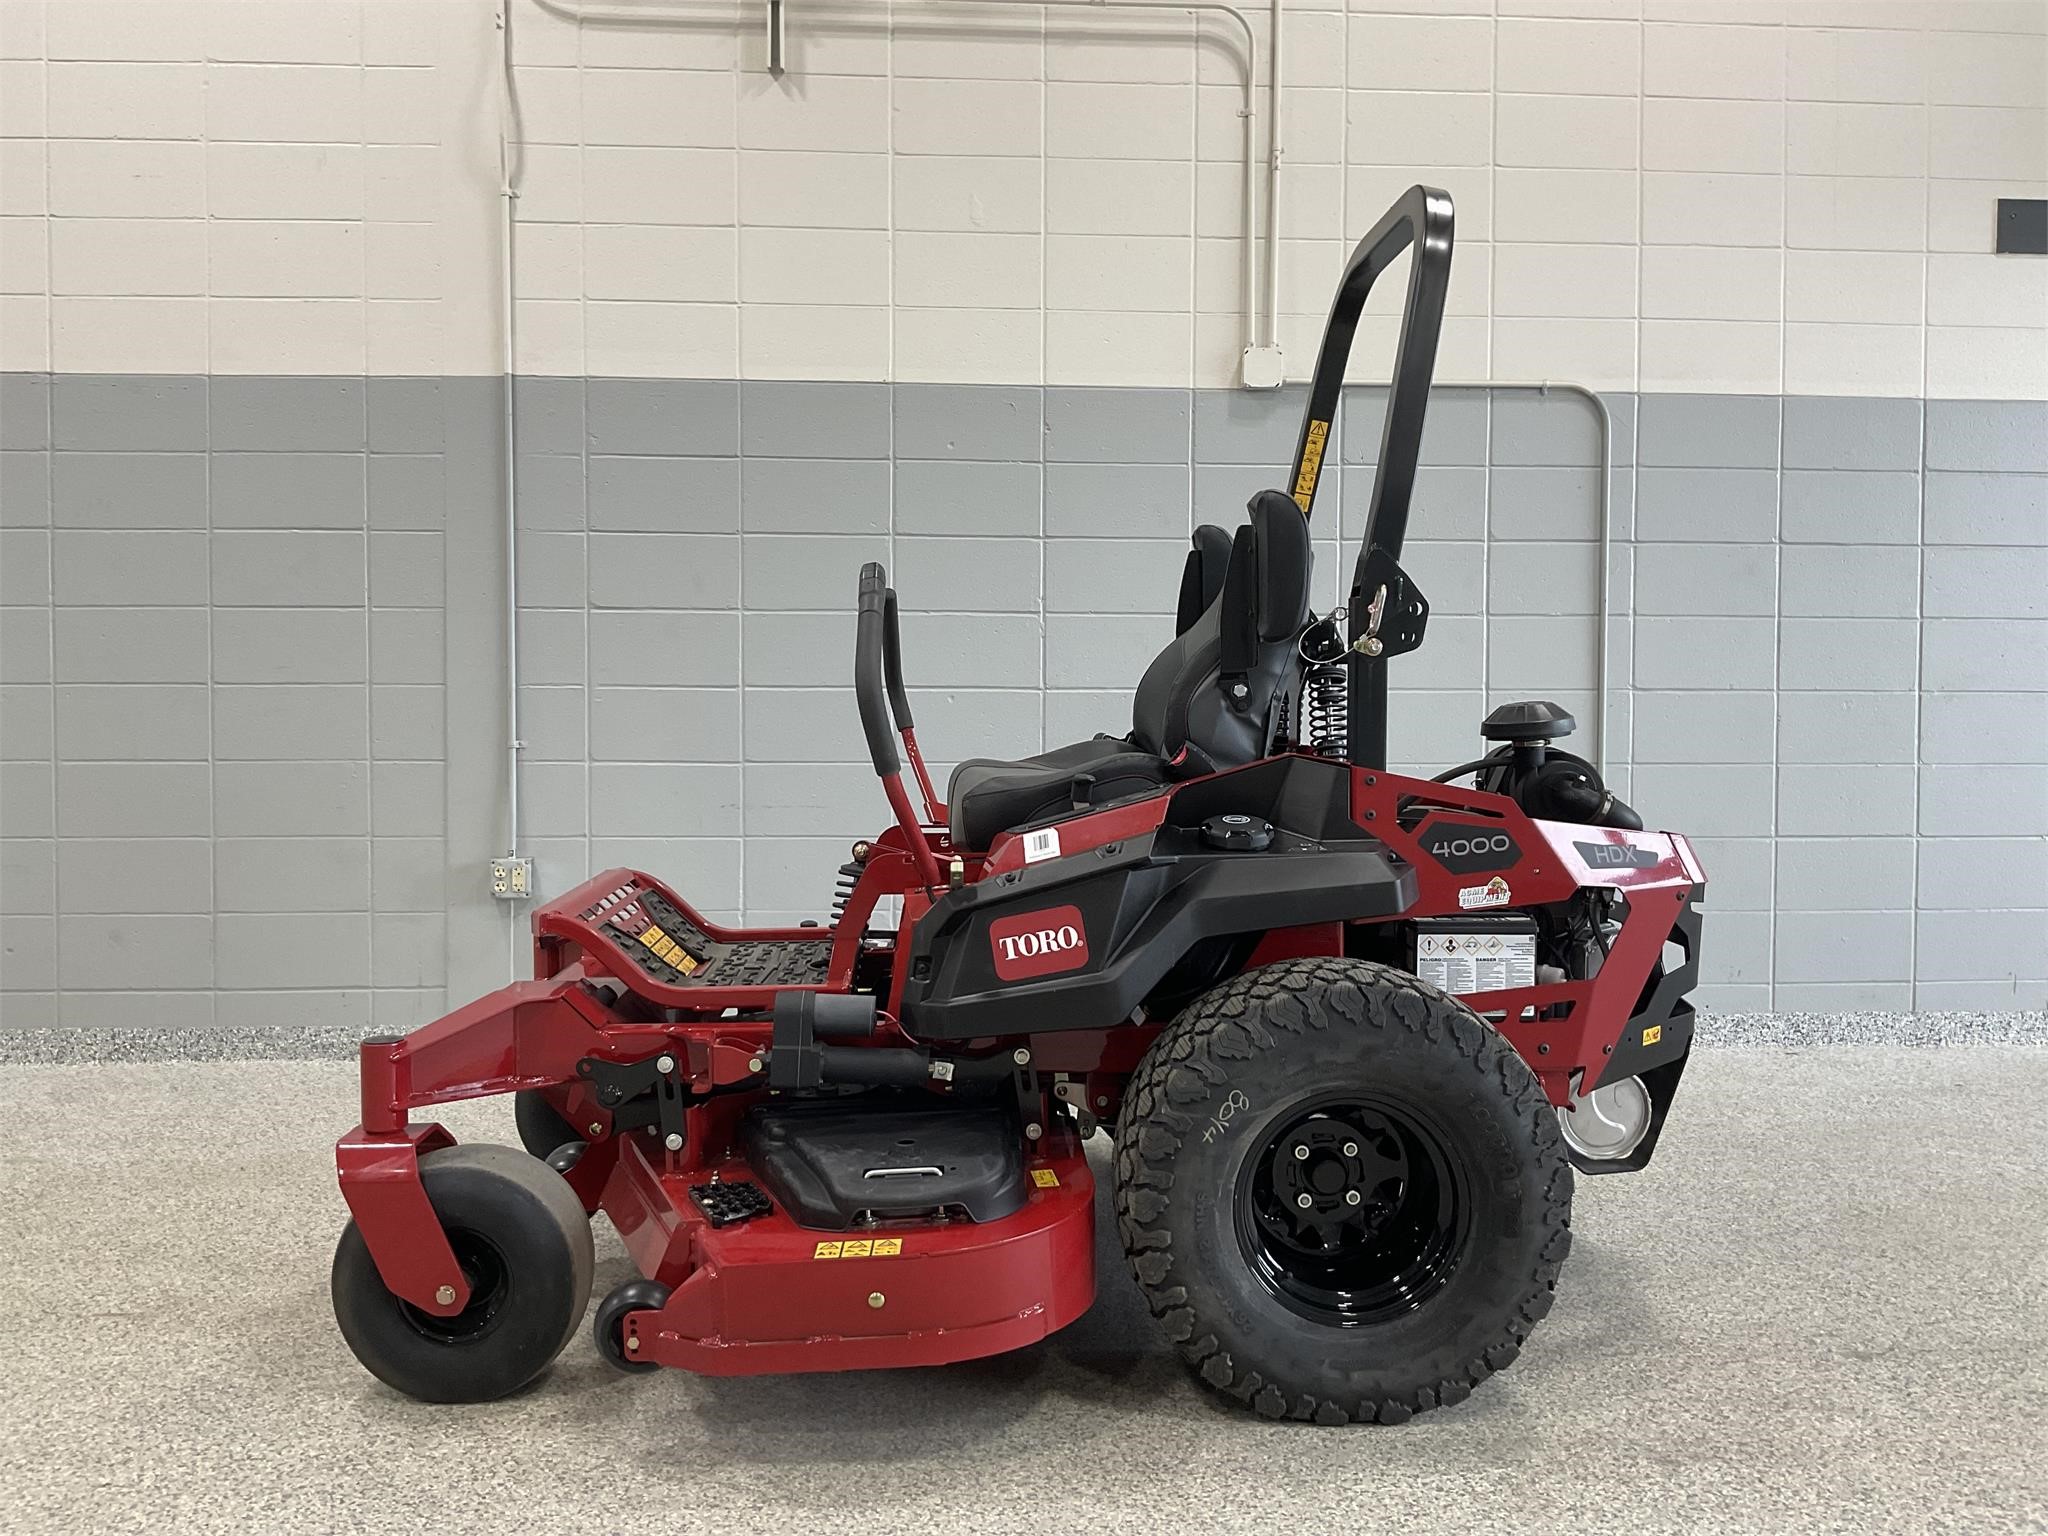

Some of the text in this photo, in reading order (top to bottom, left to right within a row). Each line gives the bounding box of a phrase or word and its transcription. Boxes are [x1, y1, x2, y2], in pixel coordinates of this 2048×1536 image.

[1432, 835, 1510, 858] 4000
[1595, 844, 1638, 863] HDX
[1461, 887, 1485, 898] ACME
[1461, 892, 1510, 906] EQUIPMENT
[999, 925, 1079, 961] TORO
